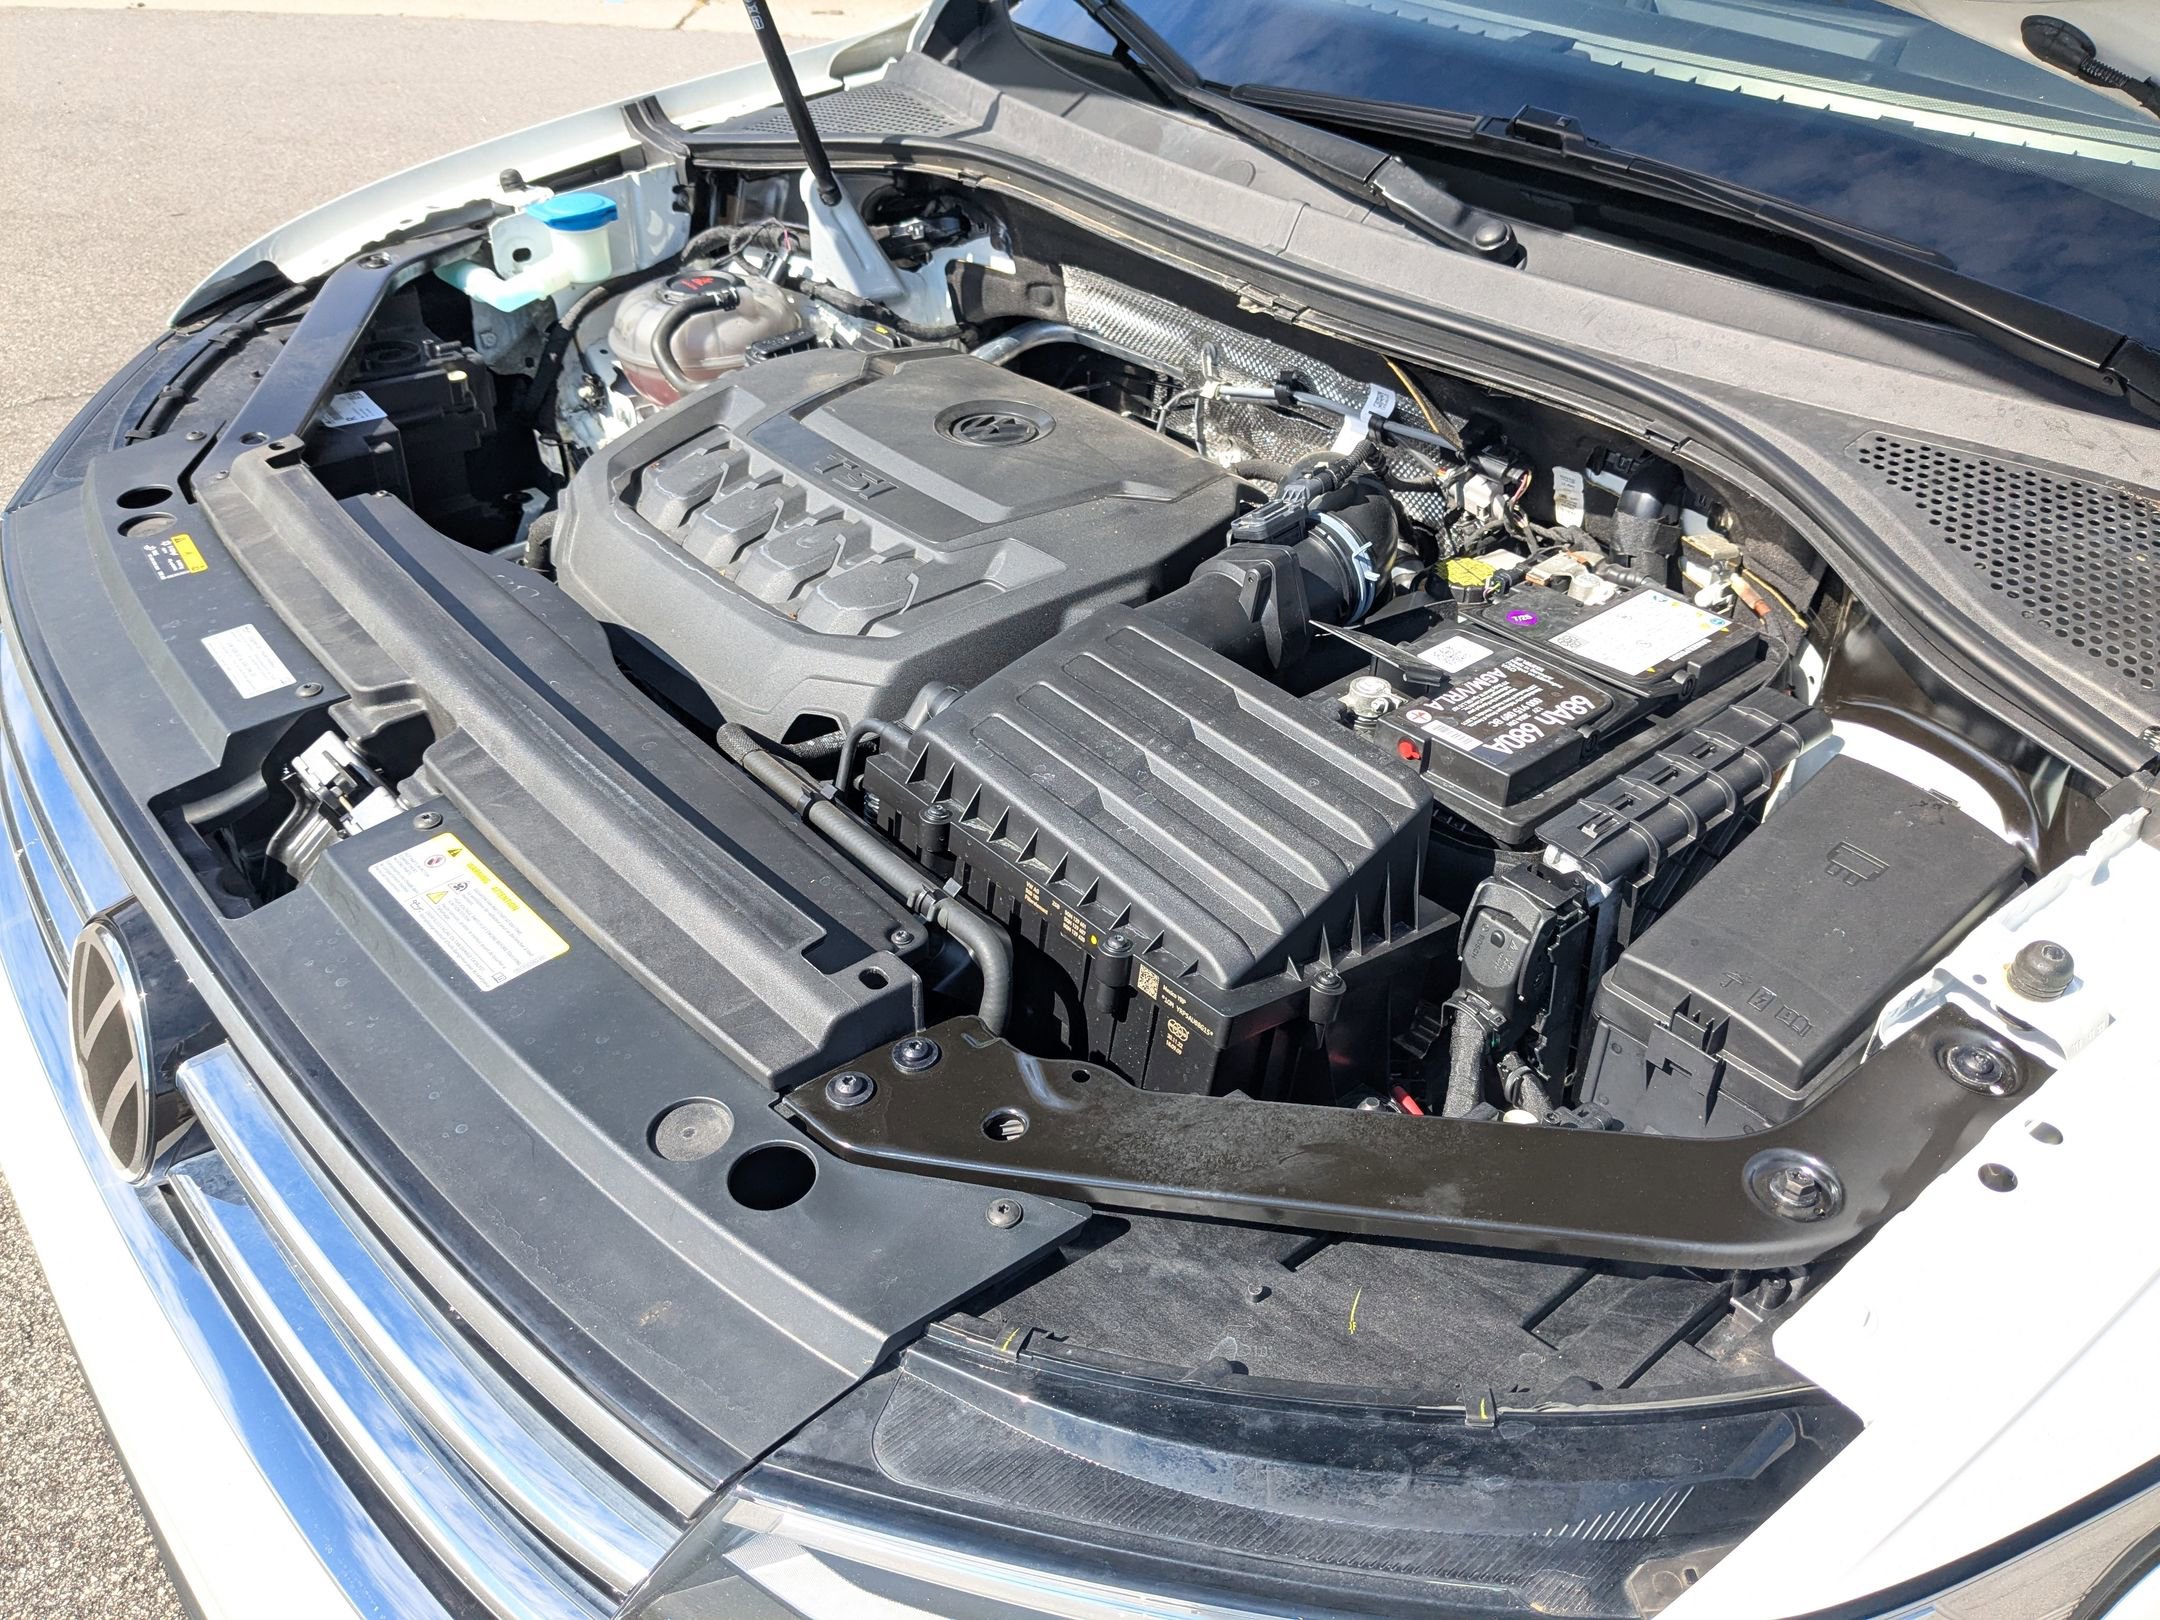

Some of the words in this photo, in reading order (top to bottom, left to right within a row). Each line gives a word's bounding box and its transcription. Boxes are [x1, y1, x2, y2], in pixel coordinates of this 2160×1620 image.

[814, 453, 900, 501] TSI
[1424, 667, 1508, 712] AGM/VRLA
[1534, 695, 1596, 726] 68Ah
[1483, 722, 1545, 755] 680A
[1471, 934, 1485, 960] BOSCH
